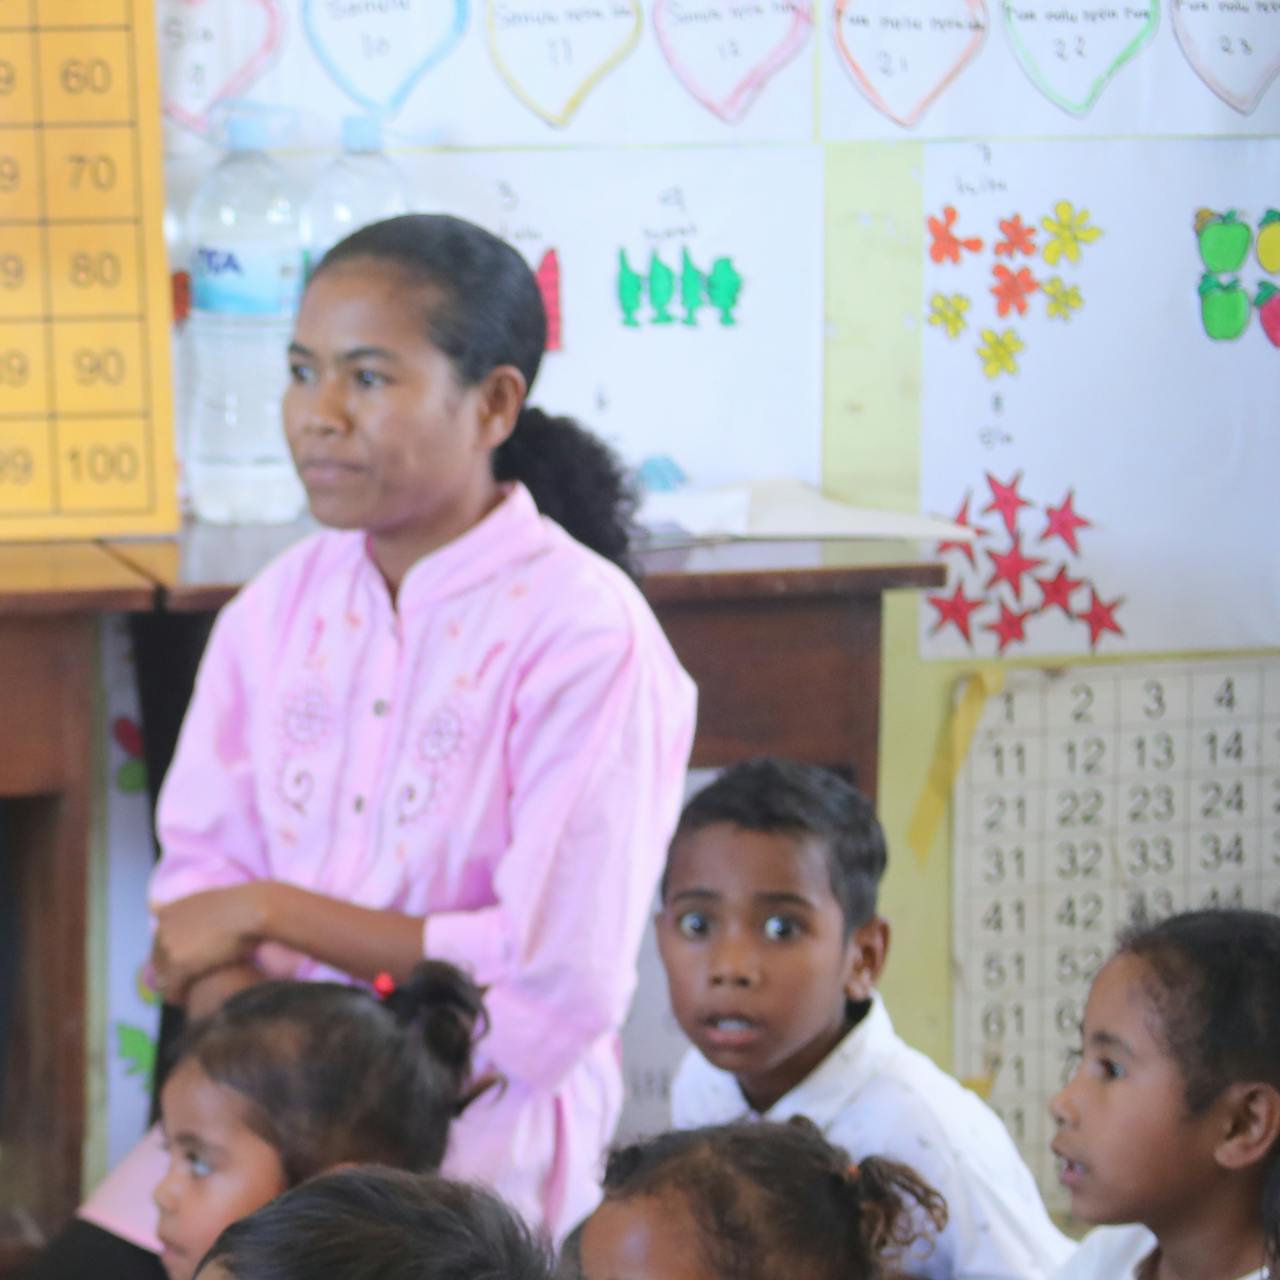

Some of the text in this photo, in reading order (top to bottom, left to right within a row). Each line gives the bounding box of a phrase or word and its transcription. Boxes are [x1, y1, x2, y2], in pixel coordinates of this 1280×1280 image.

[59, 58, 111, 95] 60
[68, 153, 116, 191] 70
[69, 250, 121, 288] 80
[73, 347, 124, 386] 90
[67, 444, 138, 482] 100
[1003, 677, 1236, 724] 1 2 3 4
[993, 729, 1244, 777] 11 12 13 14
[984, 780, 1245, 831] 21 22 23 24
[984, 832, 1244, 884] 31 32 33 34
[982, 892, 1103, 933] 41 42
[983, 949, 1102, 987] 51 52
[983, 1003, 1026, 1039] 61
